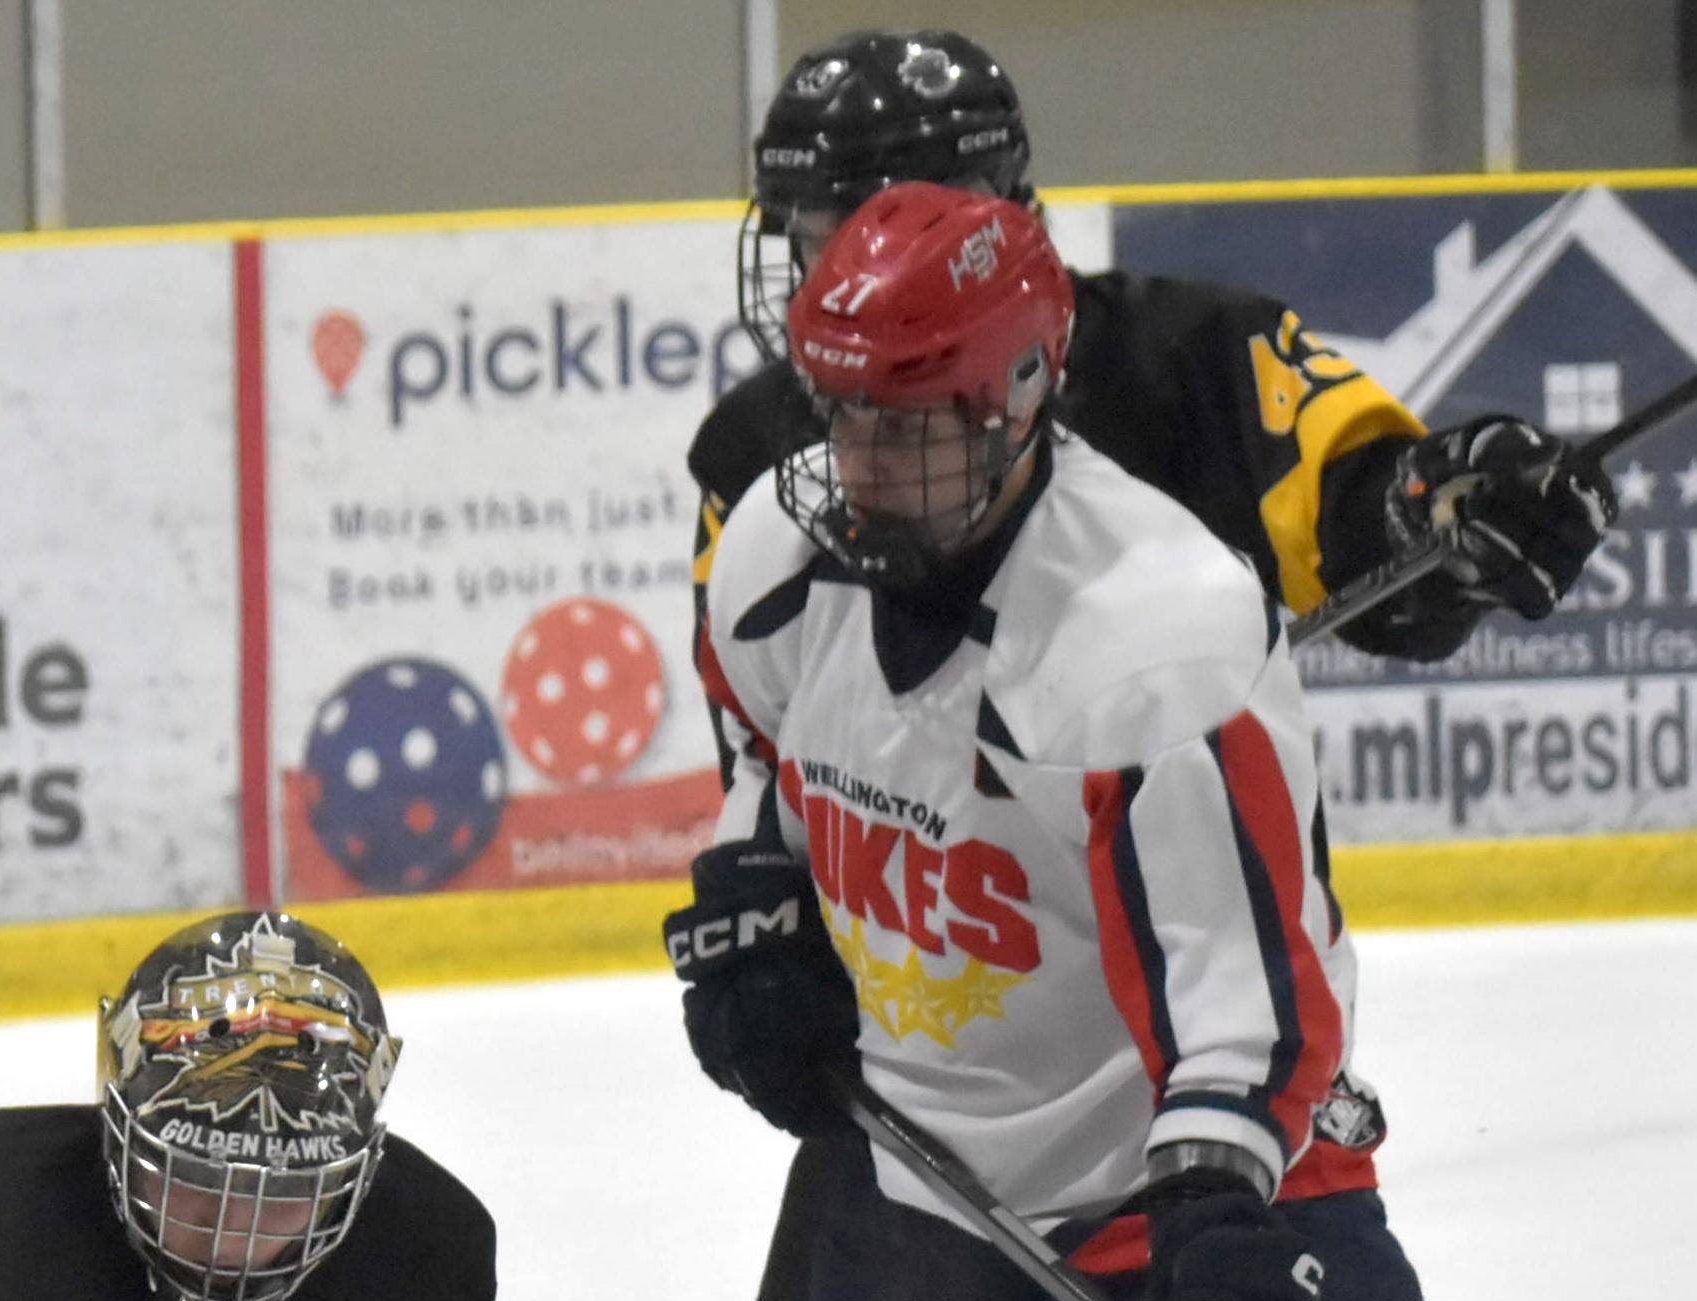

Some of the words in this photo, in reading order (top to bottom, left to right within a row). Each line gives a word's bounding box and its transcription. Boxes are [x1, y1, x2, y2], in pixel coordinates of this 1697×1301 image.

[805, 340, 867, 370] CCM
[802, 757, 947, 842] WELLINGTON
[667, 898, 800, 969] CCM
[160, 1118, 259, 1158] GOLDEN
[265, 1135, 348, 1161] HAWKS
